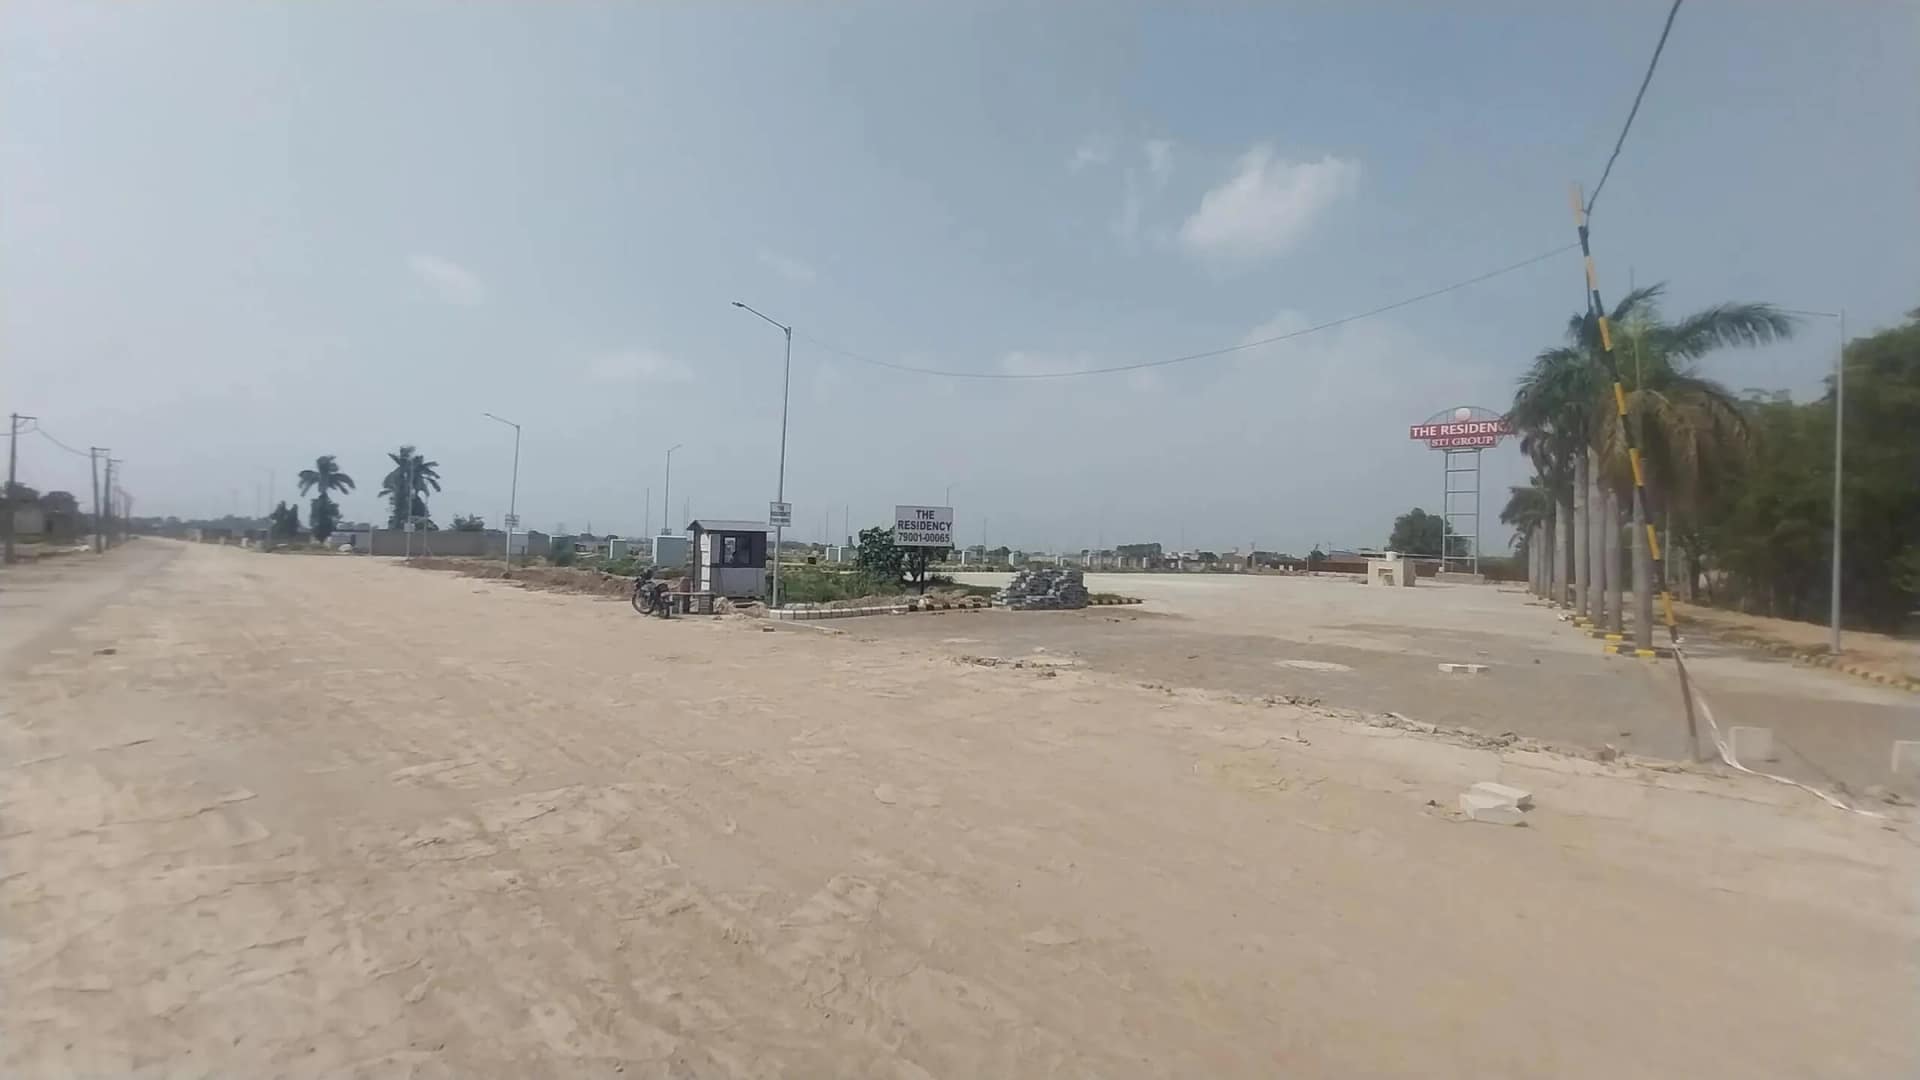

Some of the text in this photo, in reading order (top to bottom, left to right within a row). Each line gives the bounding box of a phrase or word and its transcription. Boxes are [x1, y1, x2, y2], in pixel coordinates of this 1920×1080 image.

[1411, 427, 1437, 437] THE
[1451, 436, 1494, 446] GROUP
[916, 510, 935, 520] THE
[897, 520, 952, 531] RESIDENCY
